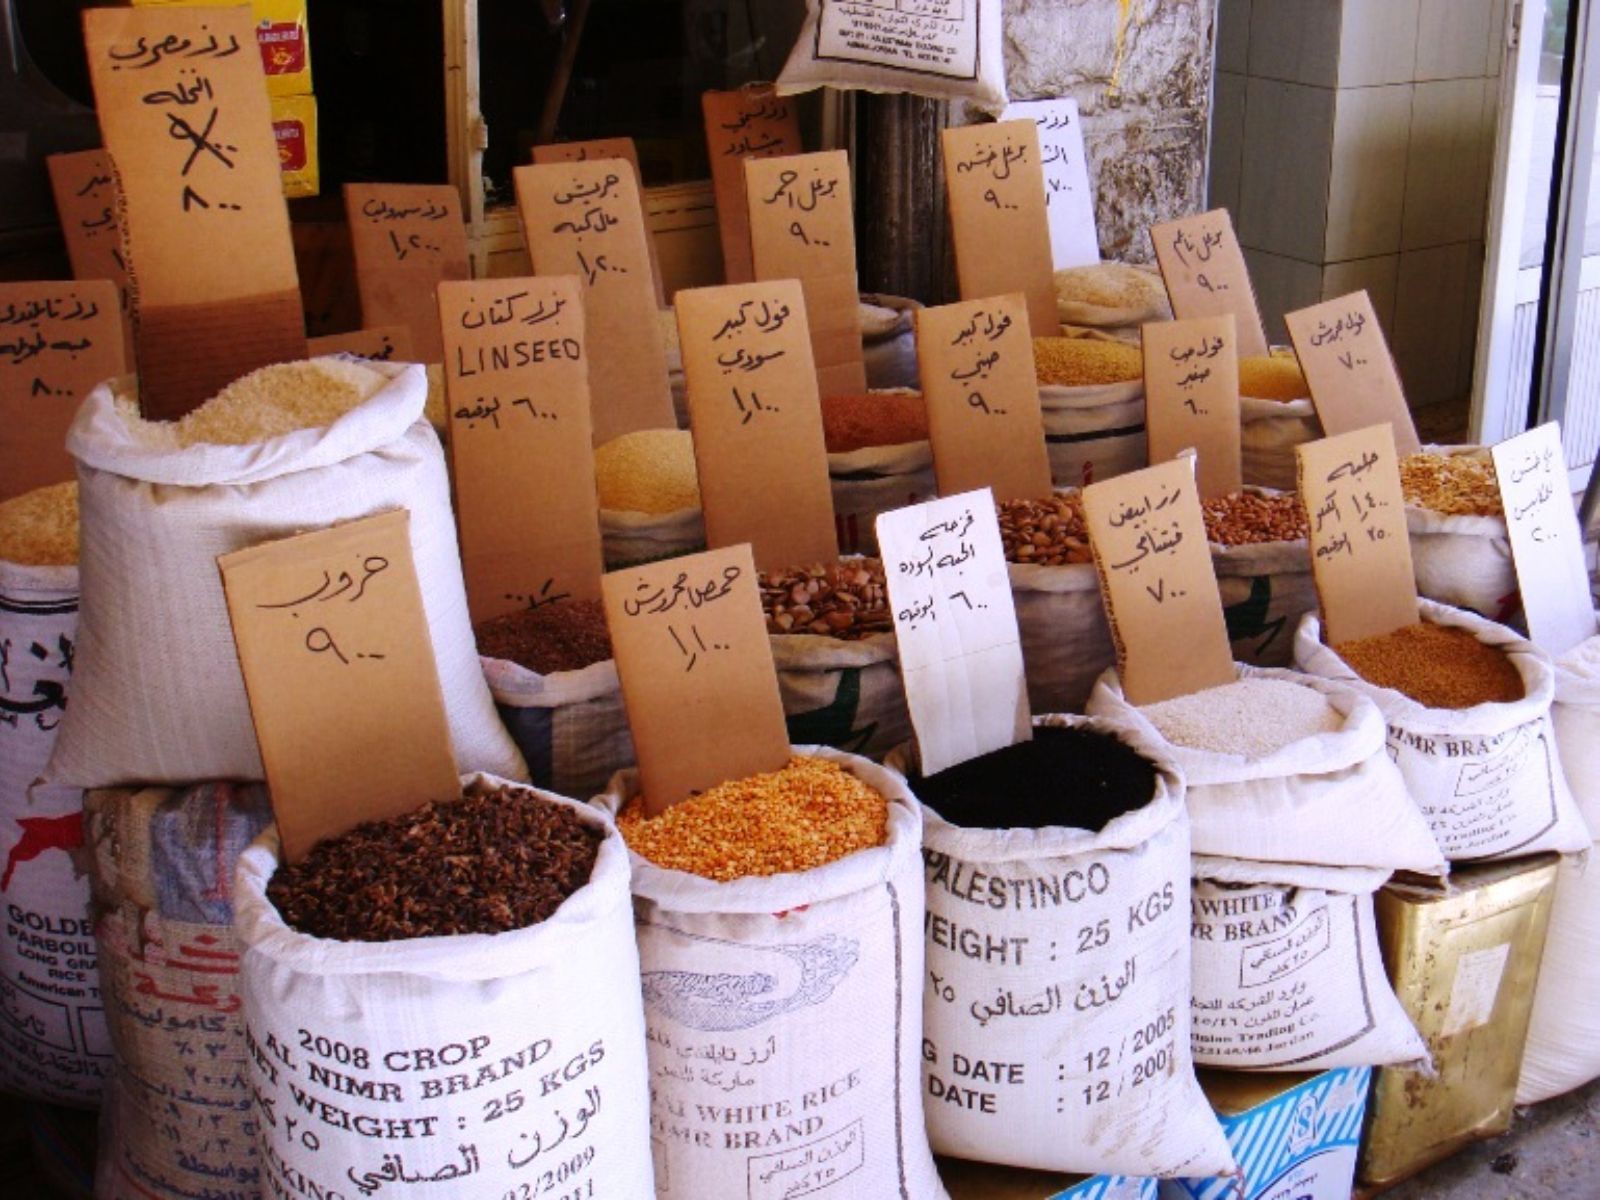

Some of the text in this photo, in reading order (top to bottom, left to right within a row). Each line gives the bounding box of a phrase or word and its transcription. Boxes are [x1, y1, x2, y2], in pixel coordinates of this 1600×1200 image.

[108, 32, 192, 68] مصري
[182, 185, 242, 213] ٨٠٠
[798, 168, 838, 211] برغل
[984, 189, 1018, 210] ٩٠٠
[789, 221, 830, 247] ٩٠٠
[1197, 273, 1229, 293] ٩٠٠
[462, 291, 529, 330] كتان
[457, 338, 581, 378] LINSEED
[1337, 352, 1368, 371] ٧٠٠
[968, 392, 1008, 415] ٩٠٠
[255, 552, 390, 619] خروب
[1145, 577, 1187, 604] ٧٠٠
[305, 626, 387, 666] ٩٠٠
[921, 845, 1110, 911] PALESTINCO
[1076, 918, 1111, 955] 25
[1127, 880, 1175, 934] KGS
[1199, 891, 1276, 917] WHITE
[969, 984, 1062, 1027] الصافي
[298, 1028, 491, 1073] 2008 CROP
[308, 1061, 405, 1103] NIMR
[420, 1037, 553, 1100] BRAND
[952, 1053, 1026, 1085] DATE
[288, 1081, 439, 1140] WEIGHT
[483, 1090, 525, 1124] 25
[538, 1038, 606, 1098] KGS
[695, 1099, 793, 1124] WHITE
[802, 1068, 861, 1111] RICE
[928, 1074, 998, 1114] DATE
[507, 1085, 602, 1169] الوزن
[723, 1115, 824, 1150] BRAND
[347, 1143, 481, 1197] الصافي
